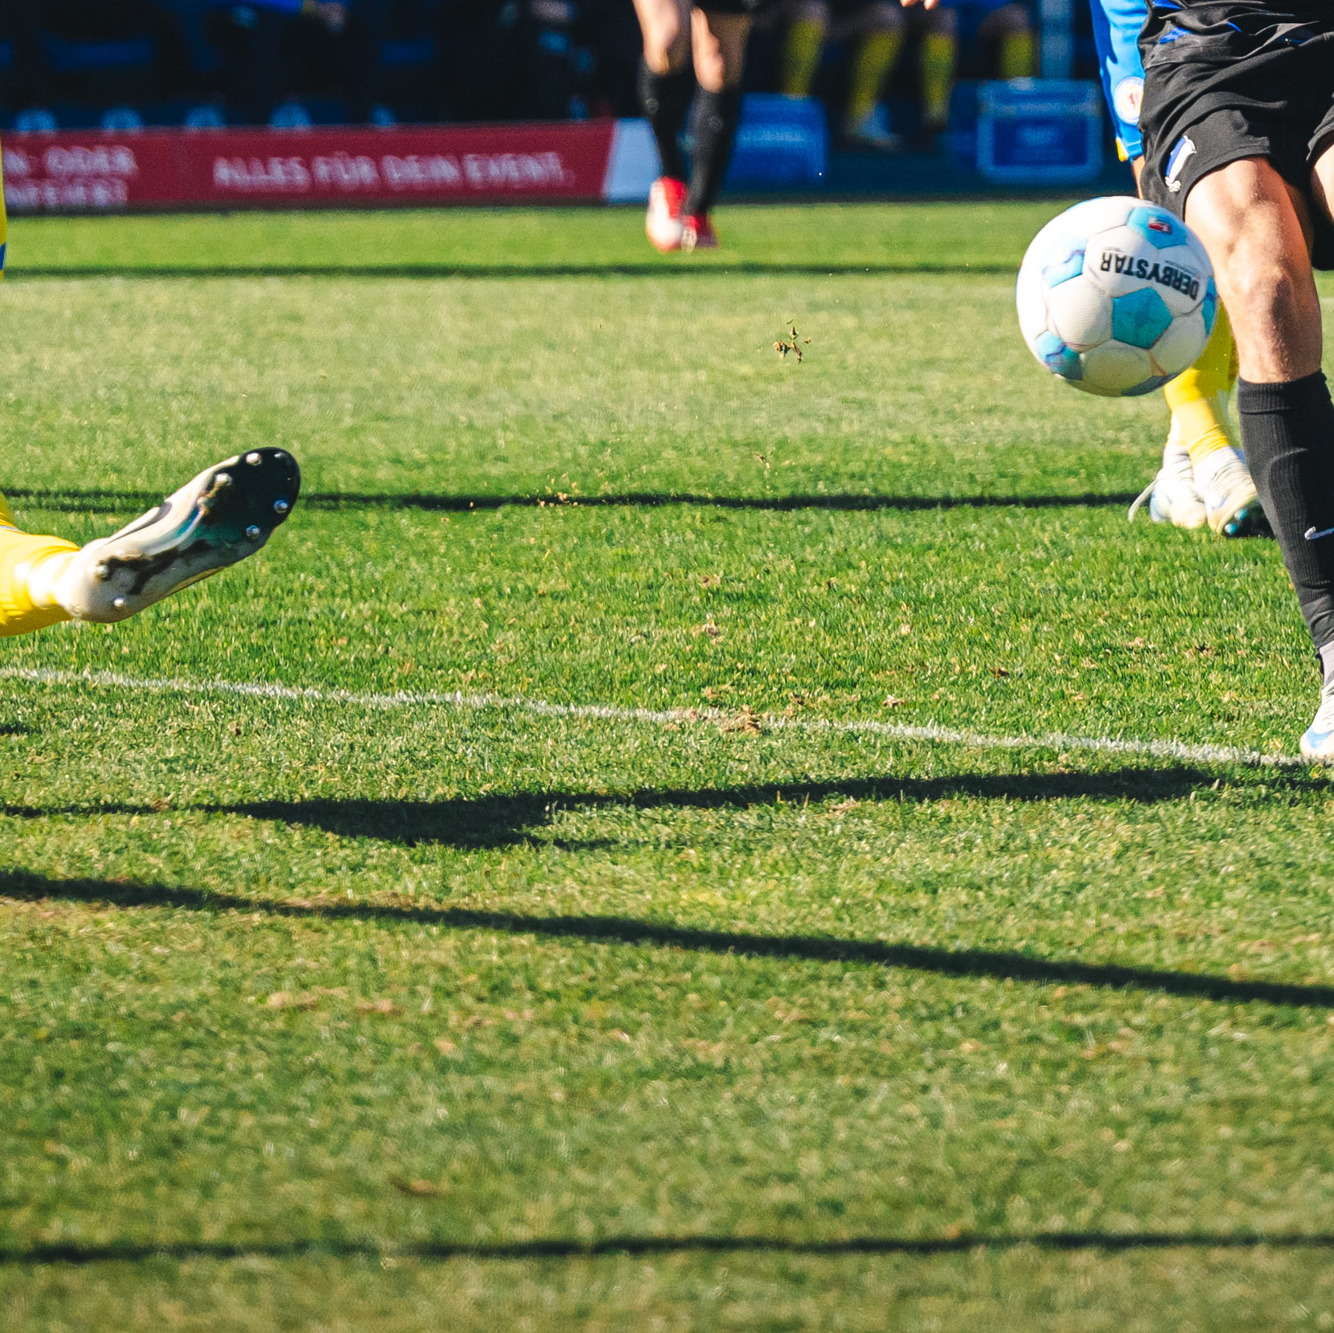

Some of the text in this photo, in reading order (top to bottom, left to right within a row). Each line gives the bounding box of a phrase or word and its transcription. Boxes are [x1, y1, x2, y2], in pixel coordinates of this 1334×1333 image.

[213, 157, 310, 192] ALLES
[312, 150, 380, 192] FÜR
[381, 154, 463, 191] DEIN
[1100, 252, 1200, 301] DERBYSTAR
